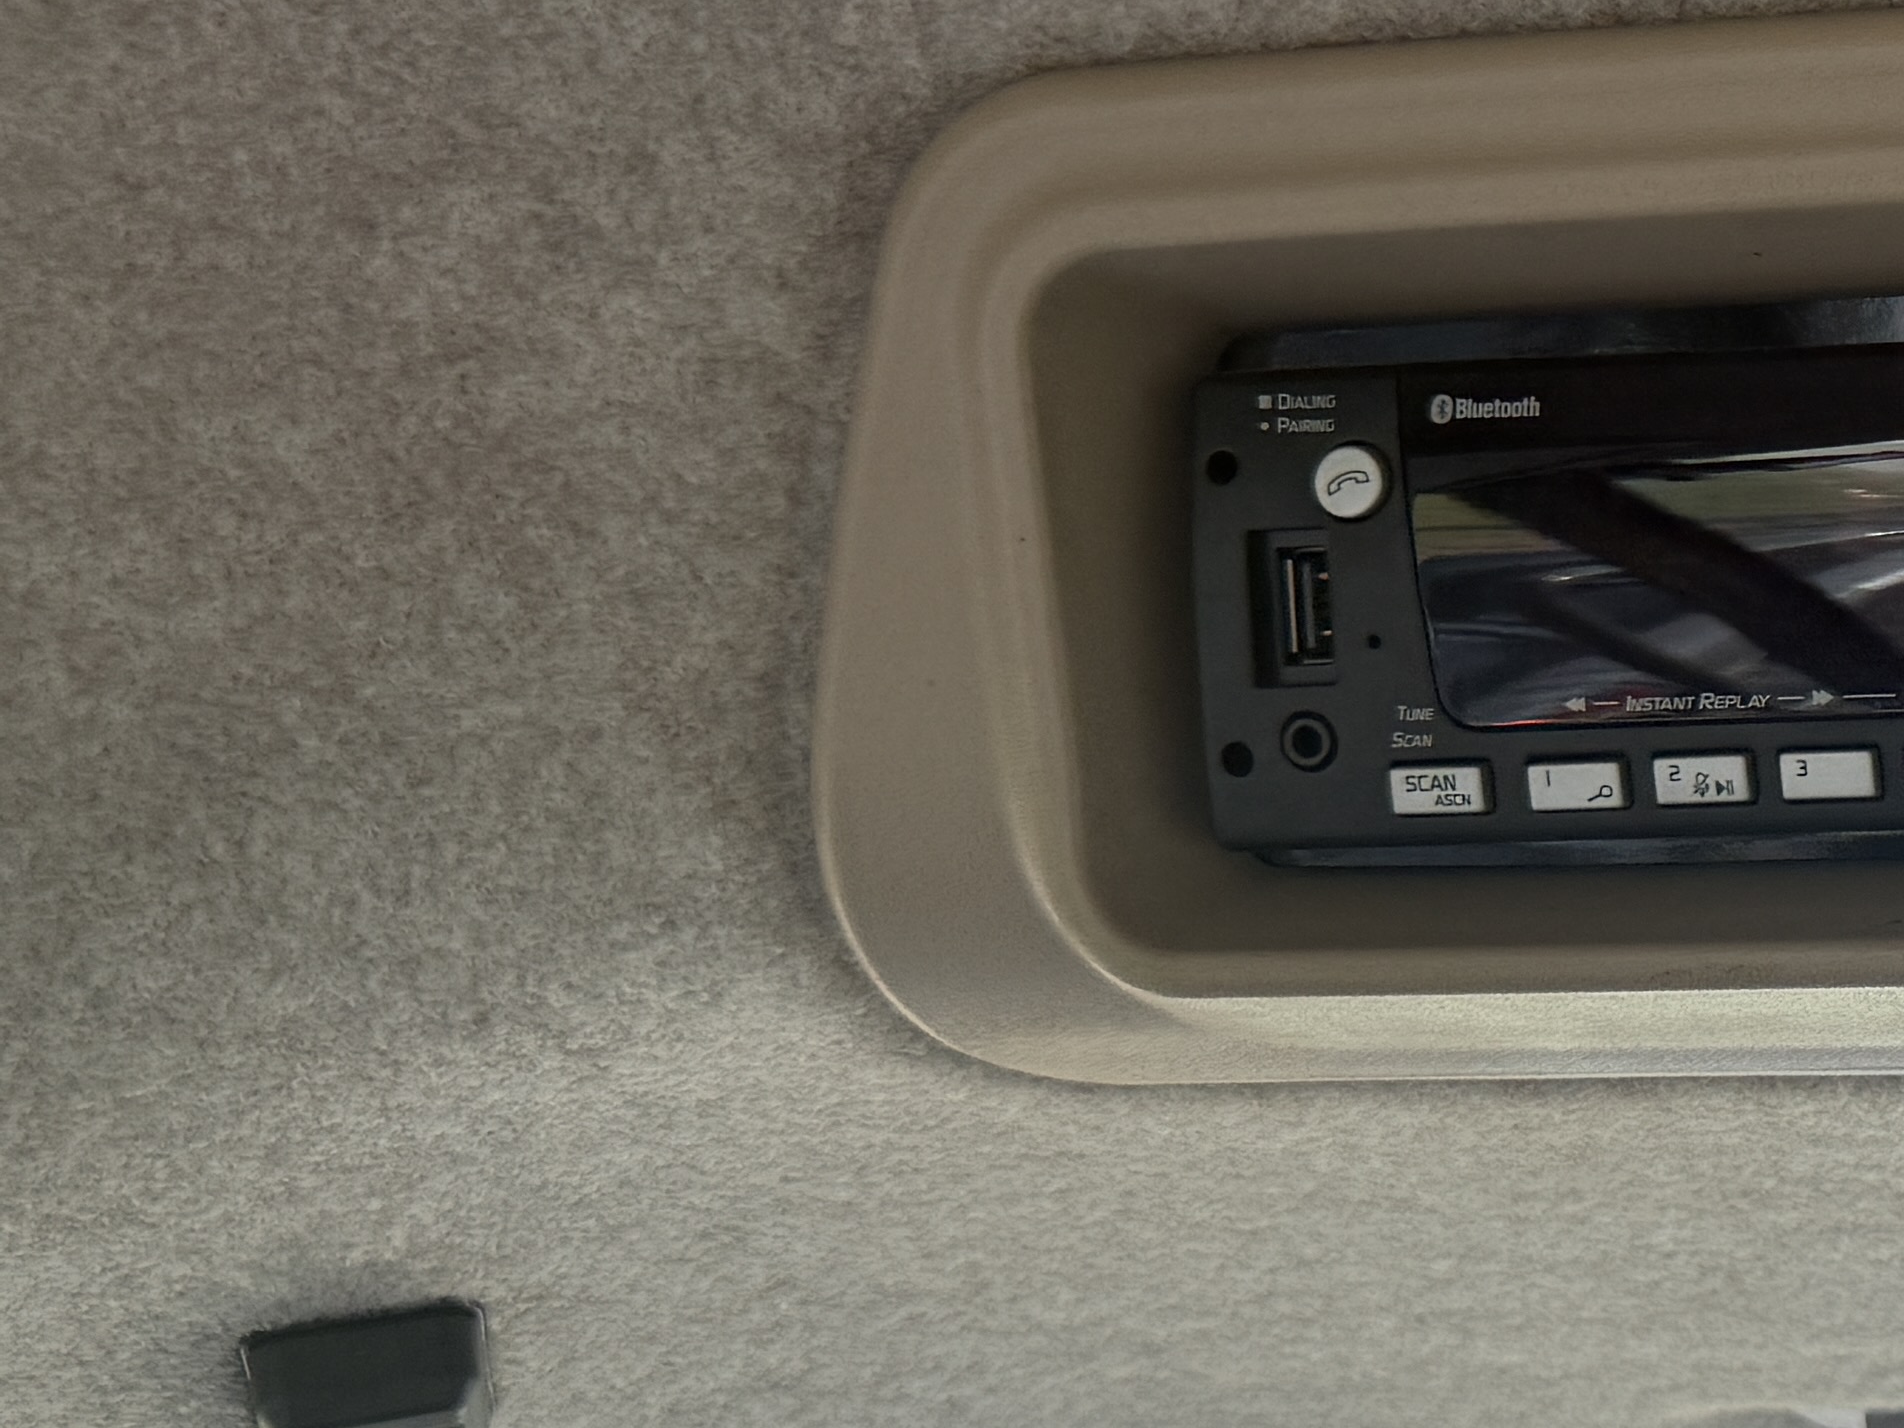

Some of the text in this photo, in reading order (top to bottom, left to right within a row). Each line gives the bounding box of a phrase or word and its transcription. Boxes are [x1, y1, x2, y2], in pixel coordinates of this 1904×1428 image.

[1455, 396, 1541, 420] Bluetooth
[1626, 692, 1771, 712] INSTANT REPLAY
[1397, 705, 1435, 721] TUNE
[1391, 732, 1432, 748] SCAN
[1668, 765, 1681, 782] 2
[1795, 759, 1808, 777] 3
[1405, 774, 1457, 793] SCAN
